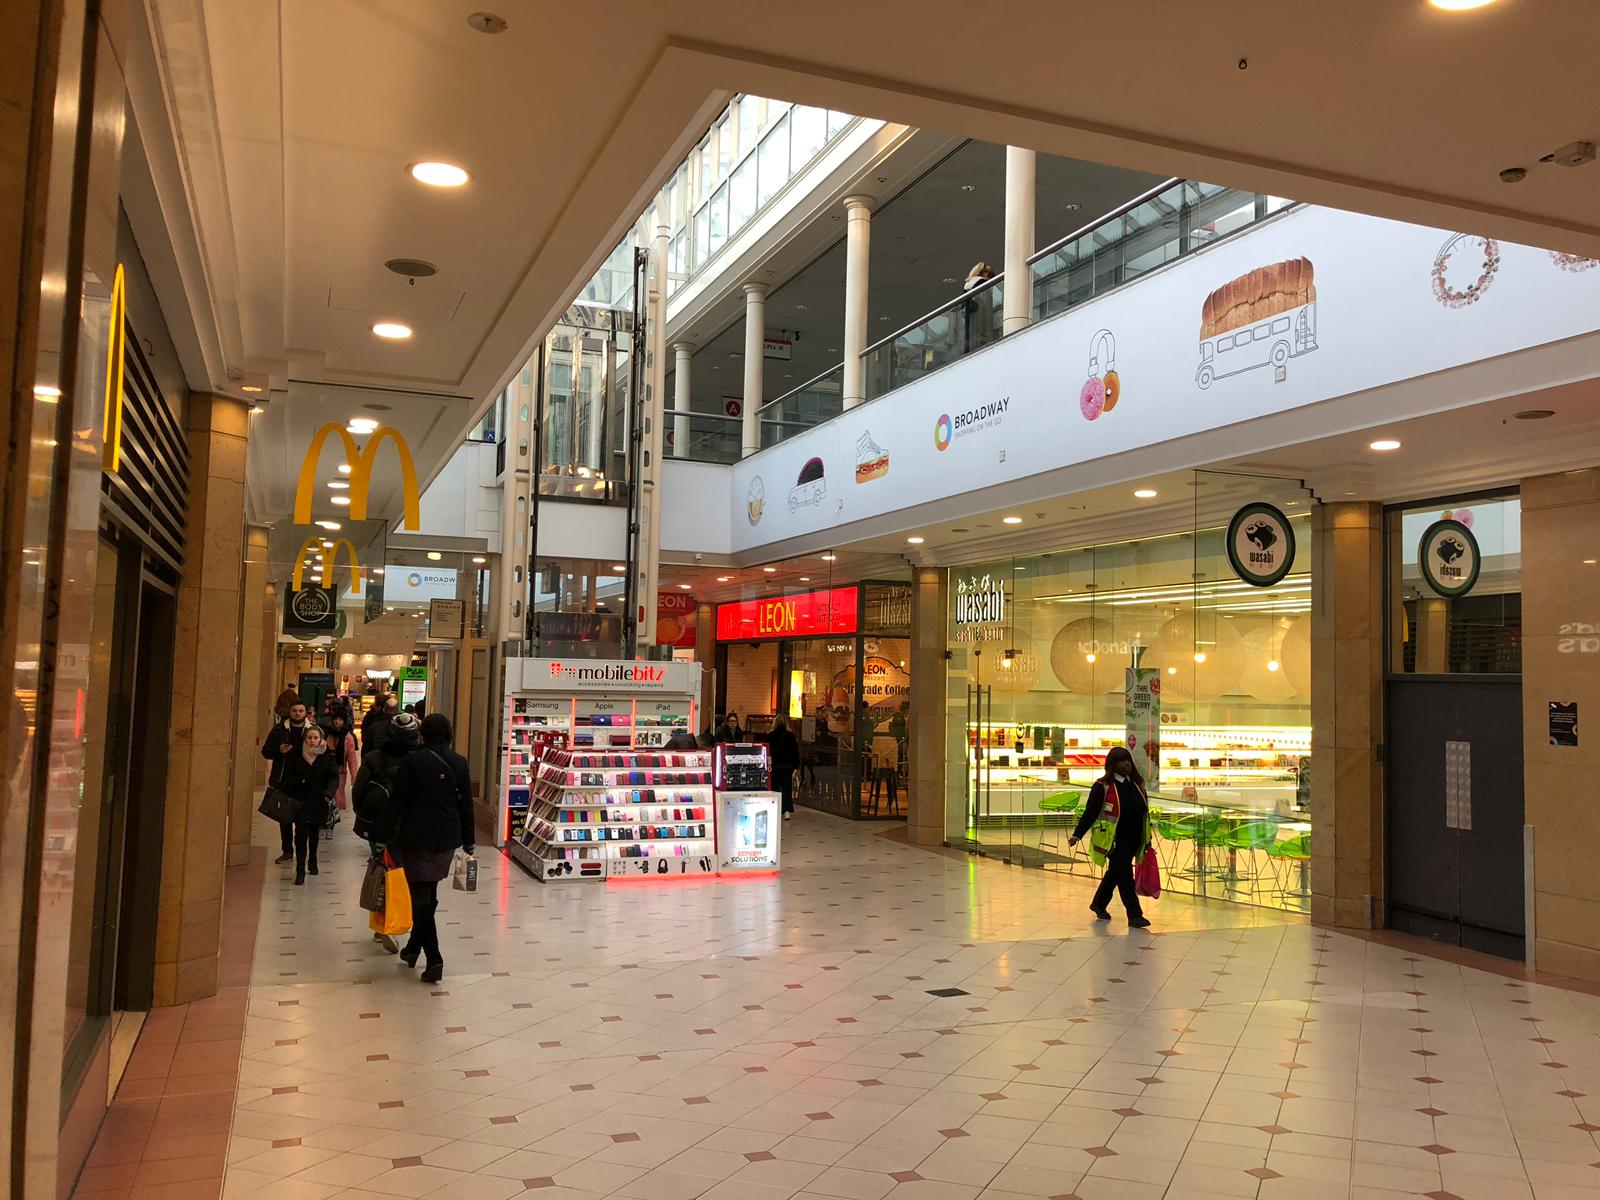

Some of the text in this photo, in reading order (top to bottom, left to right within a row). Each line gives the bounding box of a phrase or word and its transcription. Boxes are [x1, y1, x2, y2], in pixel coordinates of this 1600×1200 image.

[954, 396, 1010, 430] BROADWAY
[976, 423, 984, 432] ON
[984, 419, 993, 428] THE
[994, 416, 1002, 426] GO
[1249, 550, 1275, 564] wasabi
[657, 595, 687, 609] EON
[955, 579, 1005, 625] wasabi
[759, 600, 797, 633] LEON
[577, 664, 665, 681] mobilebitz
[863, 684, 883, 695] rade
[885, 684, 911, 695] Coffee
[1136, 684, 1149, 693] THAI
[1133, 693, 1151, 701] GREEN
[526, 701, 560, 711] Samsung
[594, 702, 615, 711] Apple
[655, 703, 672, 711] iPad
[1133, 701, 1151, 710] CURRY
